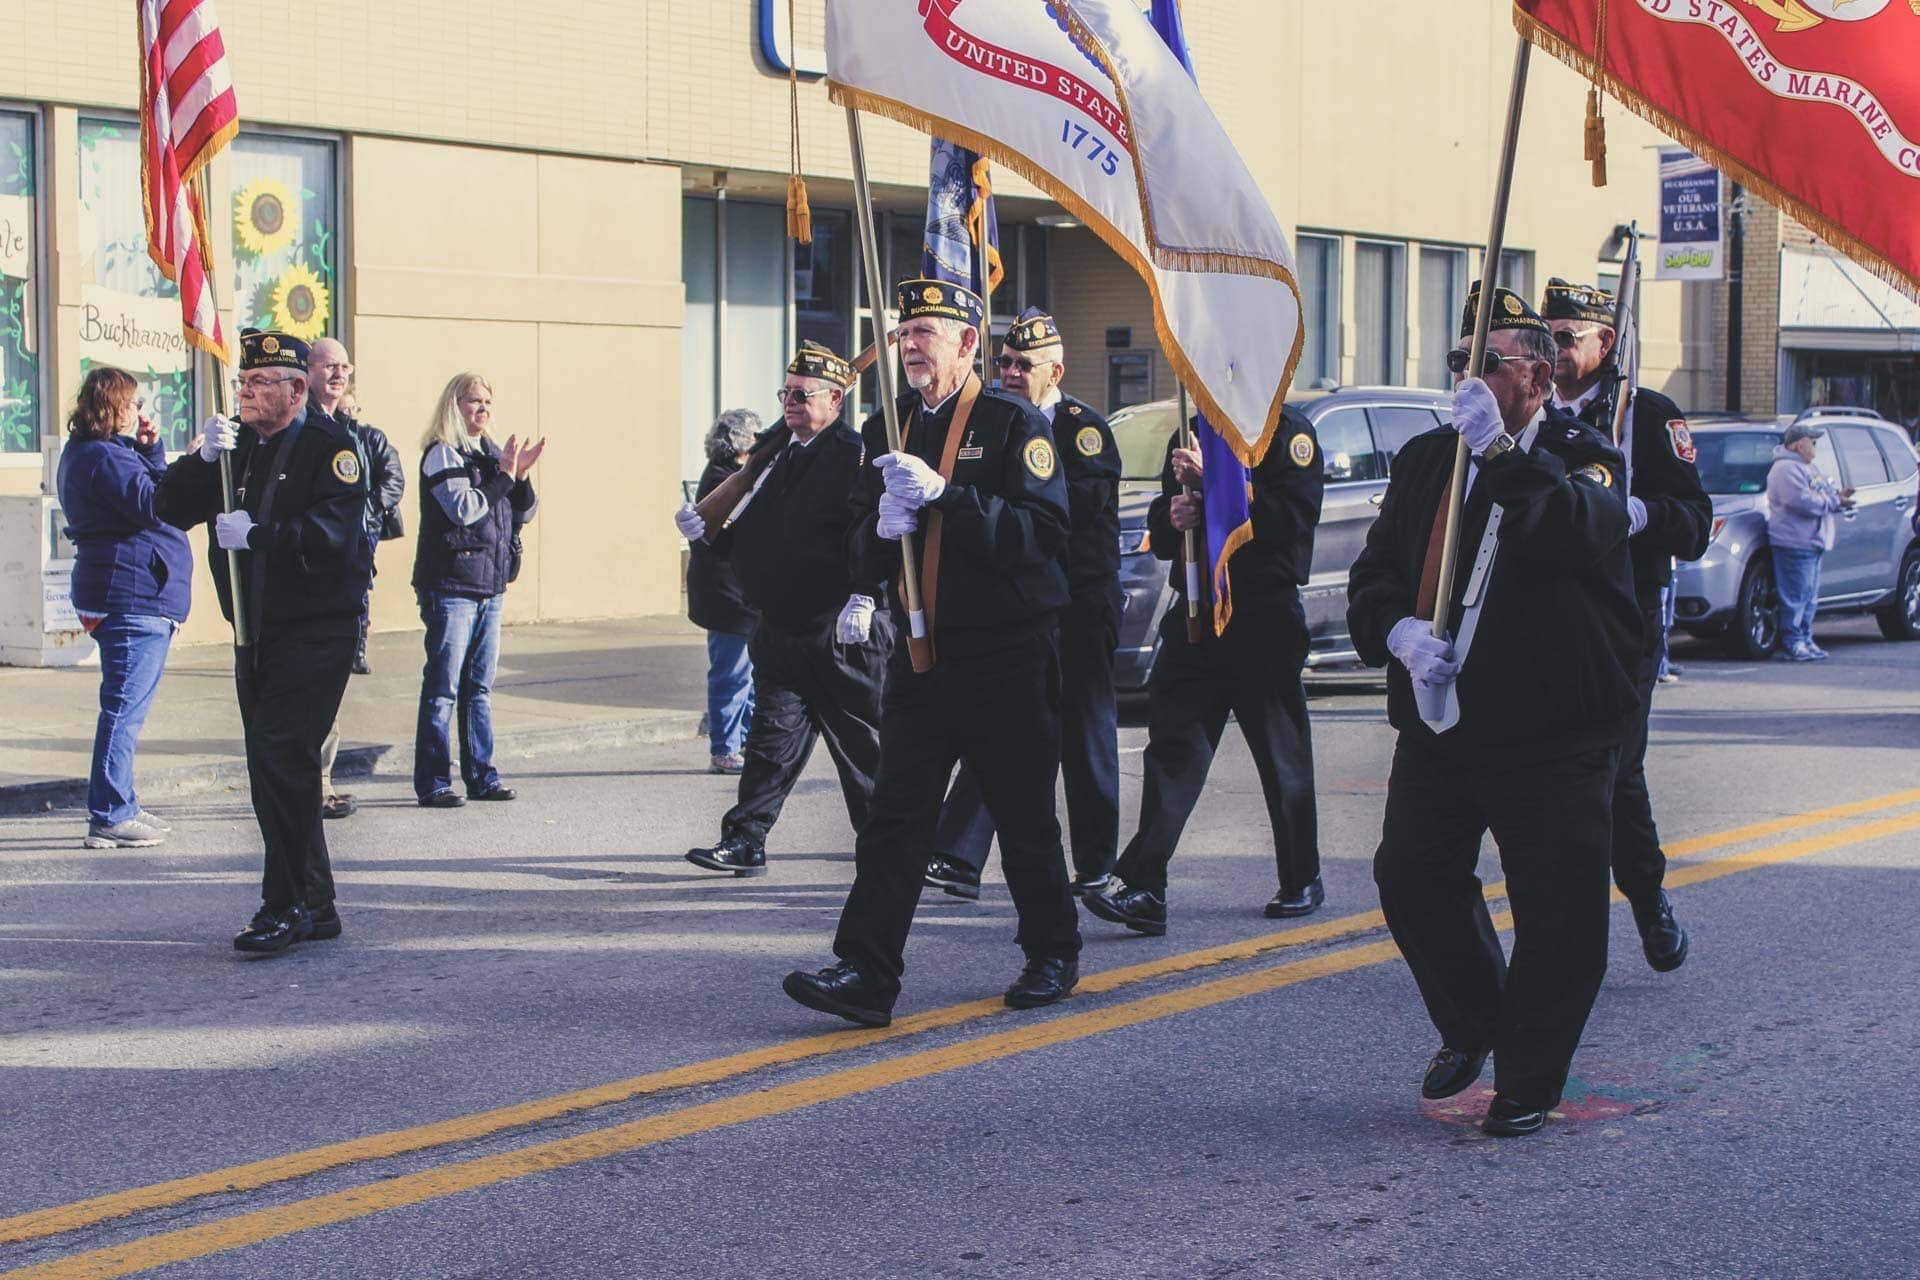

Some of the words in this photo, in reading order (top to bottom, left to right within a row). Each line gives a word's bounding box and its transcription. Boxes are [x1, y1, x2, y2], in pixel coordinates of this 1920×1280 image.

[946, 29, 1047, 85] UNITED
[1058, 76, 1129, 142] STATE
[1688, 0, 1778, 82] STATES
[1787, 73, 1893, 140] MARINE
[1062, 119, 1119, 175] 1775
[1673, 220, 1708, 231] U.S.A.
[1678, 193, 1701, 203] OUR
